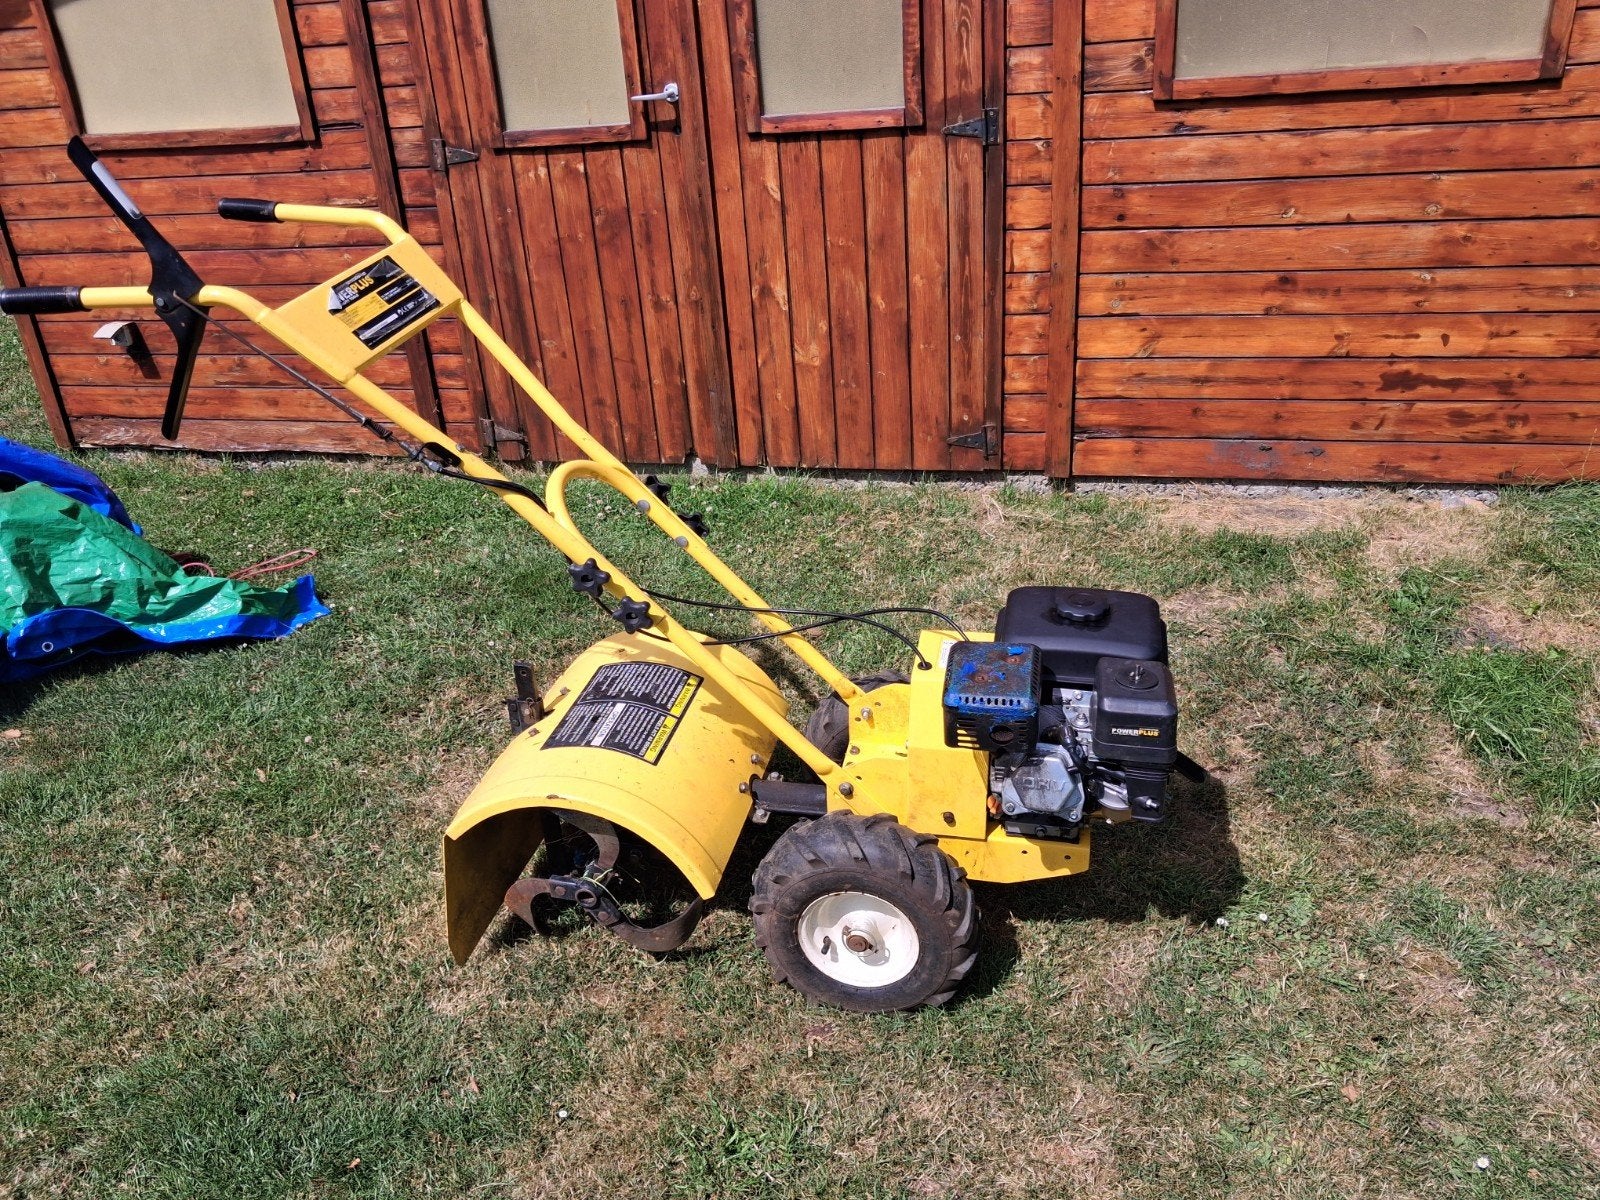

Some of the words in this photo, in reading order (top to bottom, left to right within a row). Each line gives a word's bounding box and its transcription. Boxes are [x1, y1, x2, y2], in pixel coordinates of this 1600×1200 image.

[675, 687, 691, 709] WARNING
[650, 729, 667, 753] WARNING
[1111, 727, 1160, 737] POWERPLUS
[1022, 776, 1069, 793] OHV
